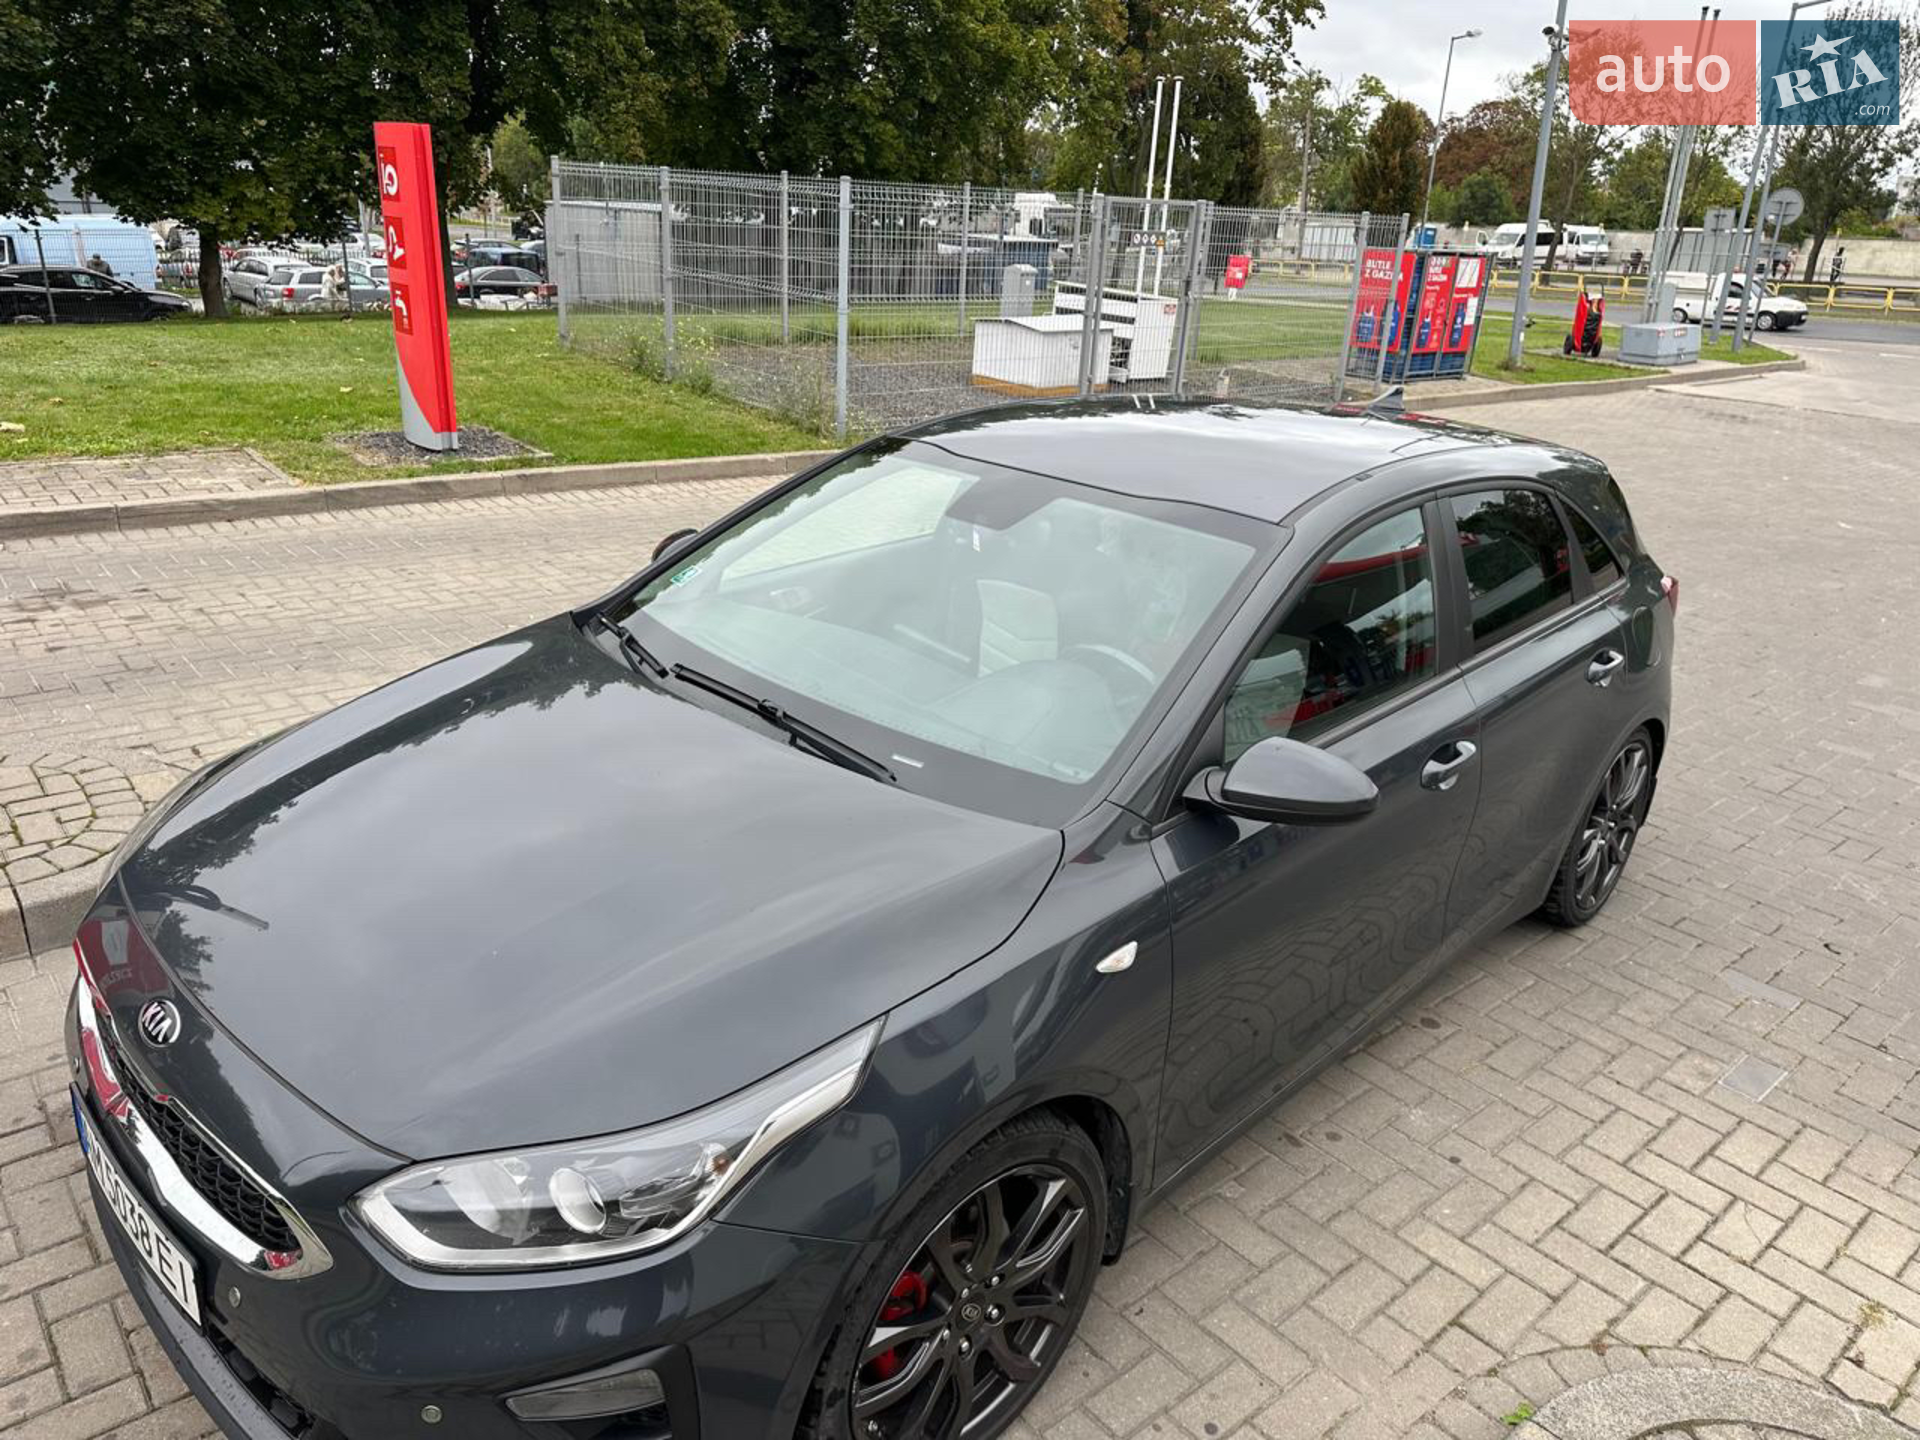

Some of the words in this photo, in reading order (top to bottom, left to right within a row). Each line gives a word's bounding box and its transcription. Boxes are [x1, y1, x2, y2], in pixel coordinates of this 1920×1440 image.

[1364, 268, 1371, 278] Z
[1366, 259, 1392, 270] BUTLE
[142, 1001, 173, 1043] KIA
[155, 1231, 189, 1304] EI
